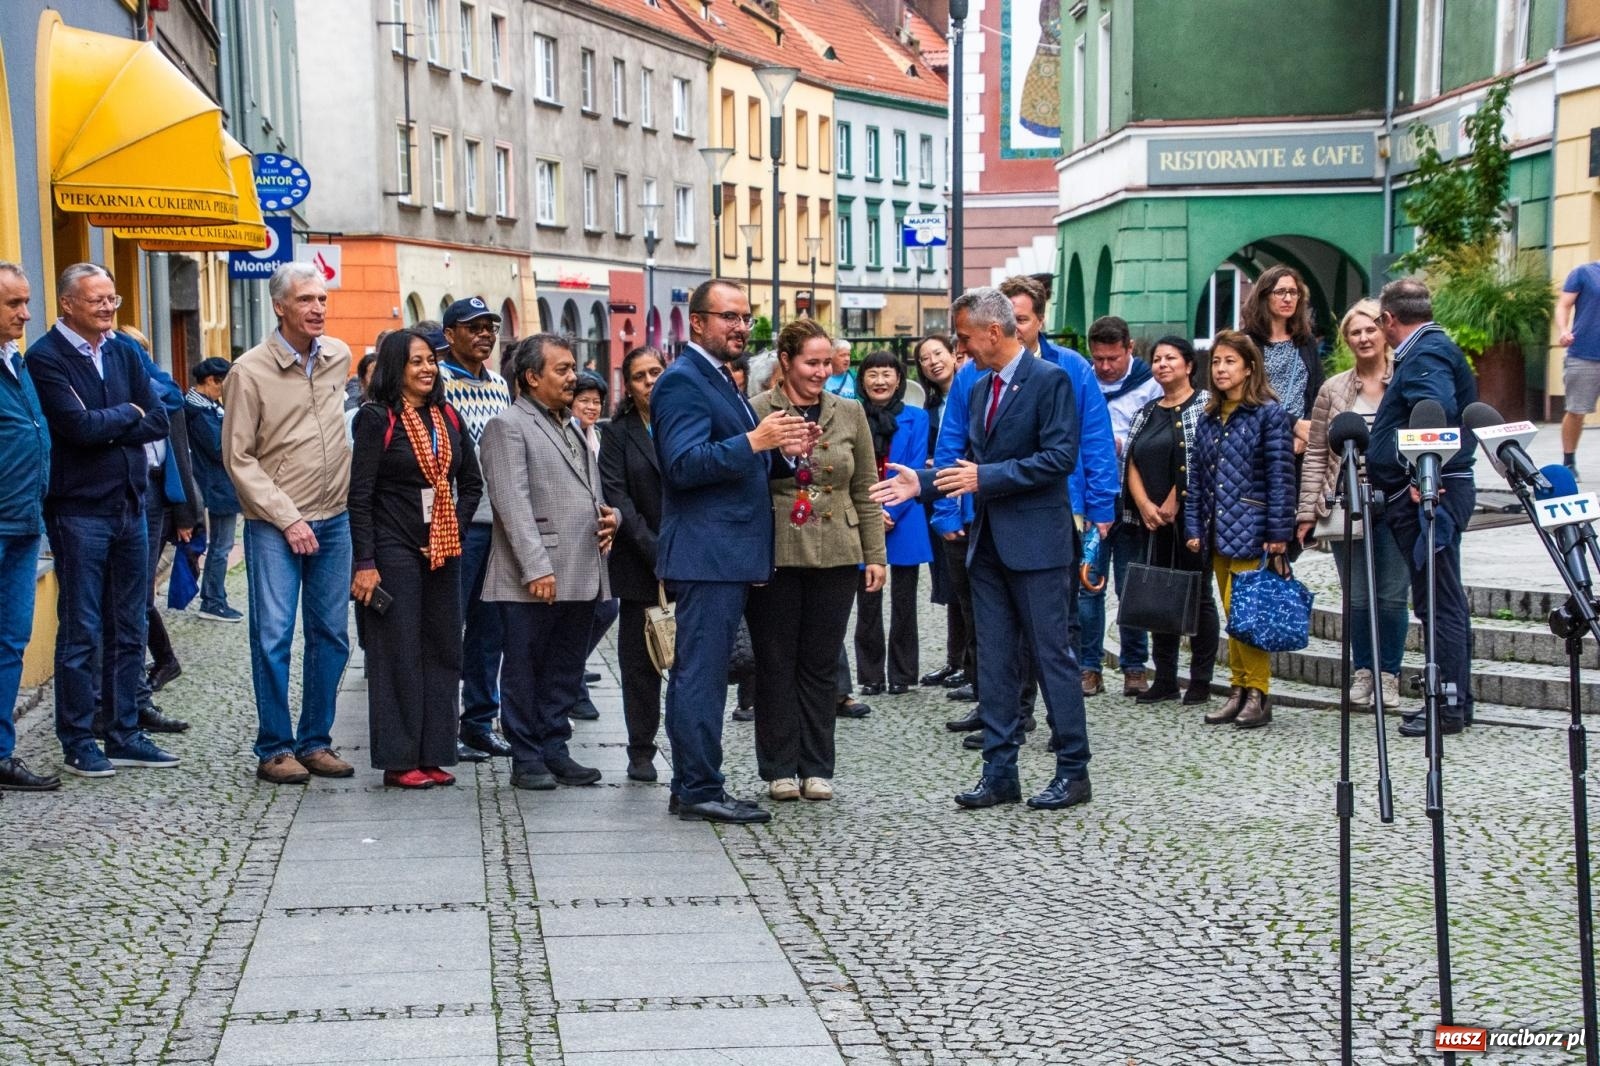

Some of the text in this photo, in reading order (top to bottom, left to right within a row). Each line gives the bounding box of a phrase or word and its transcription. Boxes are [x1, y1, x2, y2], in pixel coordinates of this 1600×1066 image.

[1160, 144, 1364, 171] RISTORANTE & CAFE
[255, 175, 293, 186] ANTOR
[60, 192, 146, 208] PIEKARNIA
[148, 196, 211, 212] CUKIERNIA
[190, 226, 243, 239] CUKIERNIA
